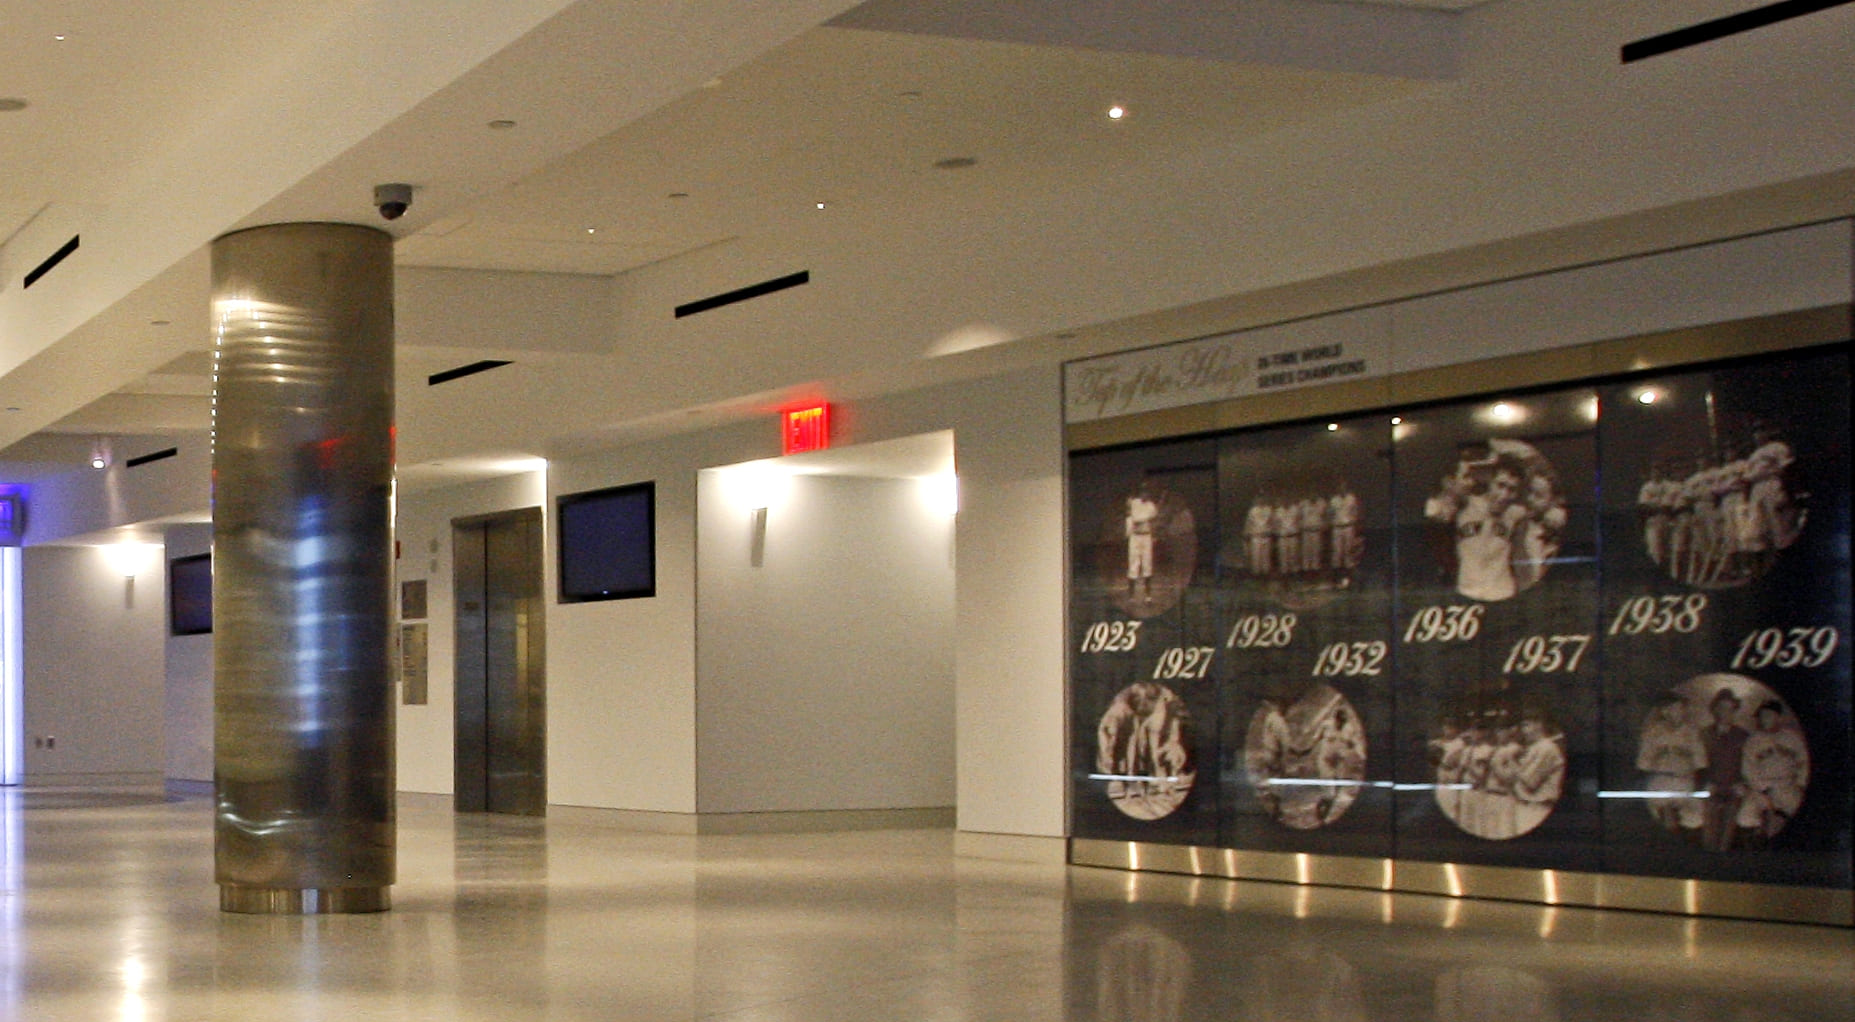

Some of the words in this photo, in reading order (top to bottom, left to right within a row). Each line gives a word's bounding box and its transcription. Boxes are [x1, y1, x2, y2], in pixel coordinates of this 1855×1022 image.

[789, 407, 823, 453] EXIT
[1226, 613, 1297, 648] 1928
[1403, 604, 1485, 643] 1936
[1608, 593, 1708, 636] 1938
[1081, 620, 1142, 652] 1923
[1502, 634, 1591, 674] 1937
[1731, 626, 1839, 669] 1939
[1153, 647, 1215, 680] 1927
[1312, 640, 1387, 677] 1932
